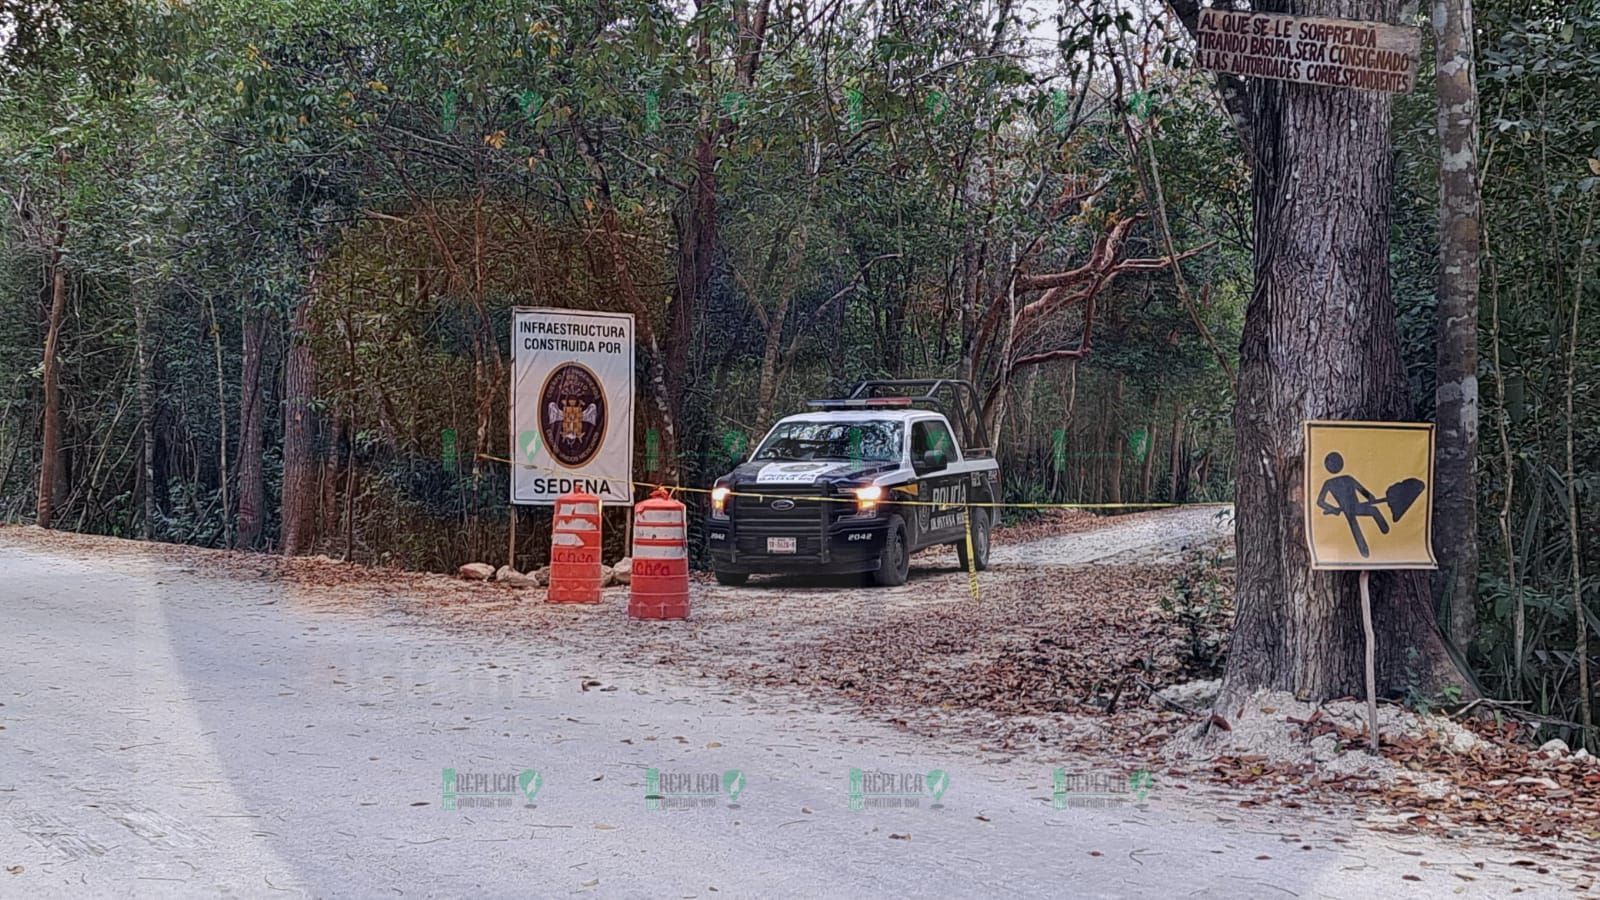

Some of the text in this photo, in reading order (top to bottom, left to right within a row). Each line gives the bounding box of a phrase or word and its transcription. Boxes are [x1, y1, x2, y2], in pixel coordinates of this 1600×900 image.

[1200, 13, 1377, 48] AL QUE SE LE SORPRENDA
[1197, 31, 1248, 53] TIRANDO
[1329, 45, 1410, 71] CONSIGNADO
[1206, 51, 1229, 71] LAS
[1231, 54, 1301, 79] AUTORIDADES
[1306, 64, 1409, 93] CORRESPONDIENTES
[520, 321, 625, 338] INFRAESTRUCTURA
[524, 338, 621, 354] CONSTRUIDA POR
[533, 478, 611, 494] SEDENA
[847, 532, 872, 541] 2042
